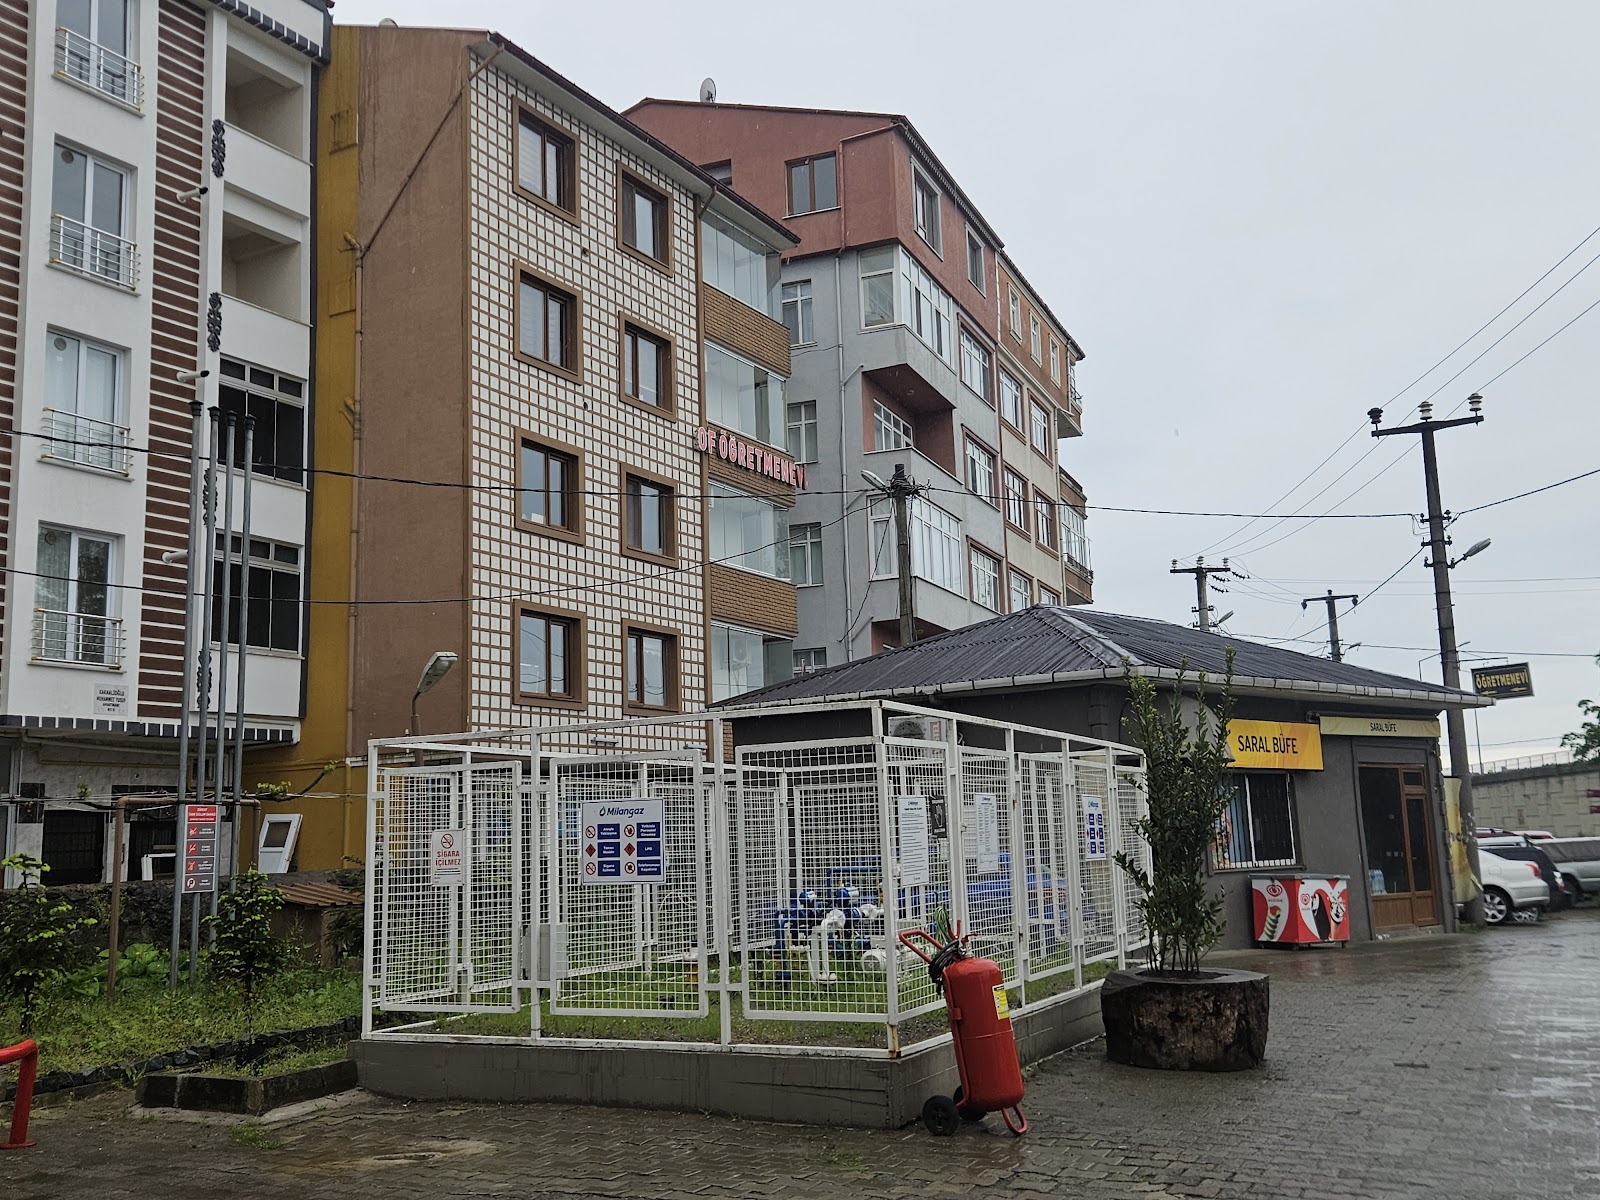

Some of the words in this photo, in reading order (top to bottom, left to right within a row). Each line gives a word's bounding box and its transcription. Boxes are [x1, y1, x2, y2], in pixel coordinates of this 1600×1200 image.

[698, 427, 716, 454] OF
[1475, 670, 1529, 689] ÖĞRETMENEVİ
[1370, 722, 1385, 732] SARAL
[1385, 721, 1397, 733] BÜFE
[1238, 735, 1271, 753] SARAL
[1273, 734, 1298, 754] BÜFE
[606, 807, 645, 818] Milangaz
[437, 849, 460, 857] SİGARA
[435, 857, 461, 867] İÇİLMEZ
